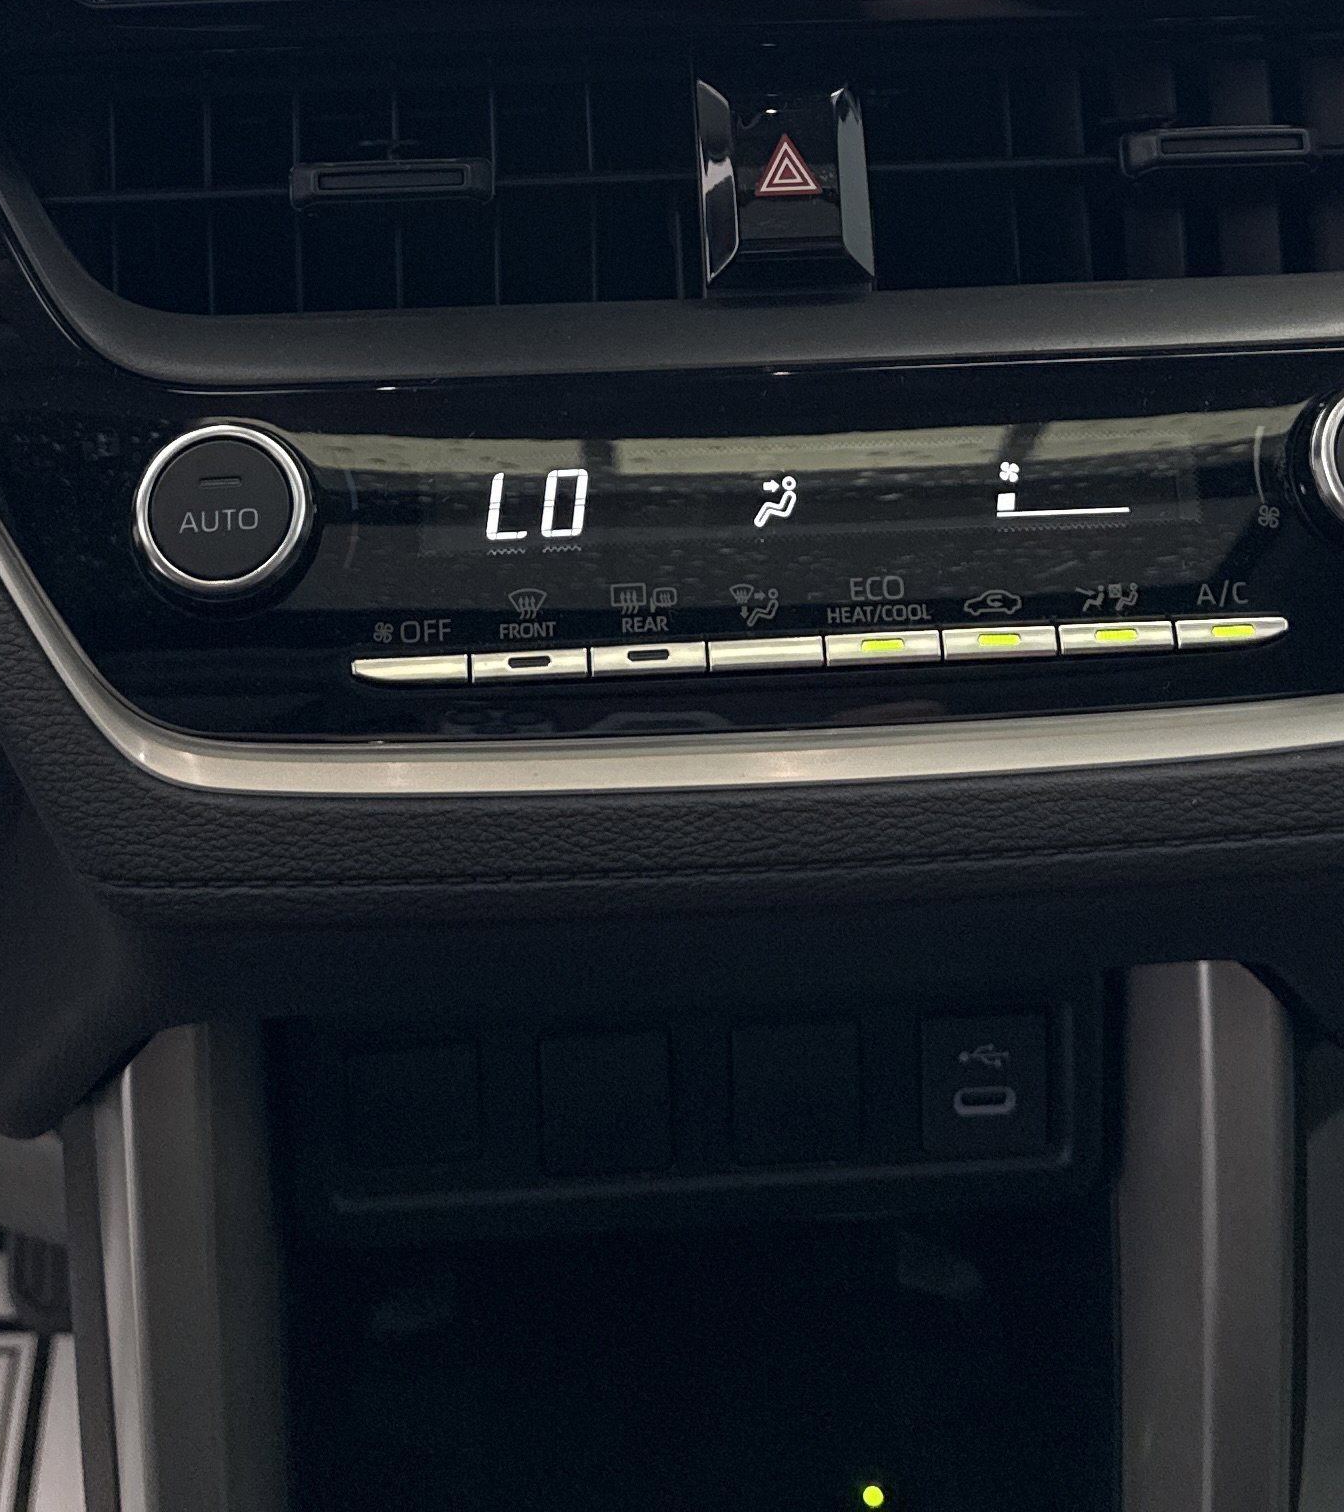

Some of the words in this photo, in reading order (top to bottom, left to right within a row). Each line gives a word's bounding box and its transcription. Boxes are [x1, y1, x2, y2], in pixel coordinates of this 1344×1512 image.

[485, 467, 589, 541] LO
[178, 507, 260, 535] AUTO
[849, 575, 905, 601] ECO
[1196, 578, 1250, 608] A/C
[620, 614, 670, 634] REAR
[826, 603, 933, 625] HEAT/COOL
[399, 618, 453, 644] OFF
[498, 620, 557, 640] FRONT
